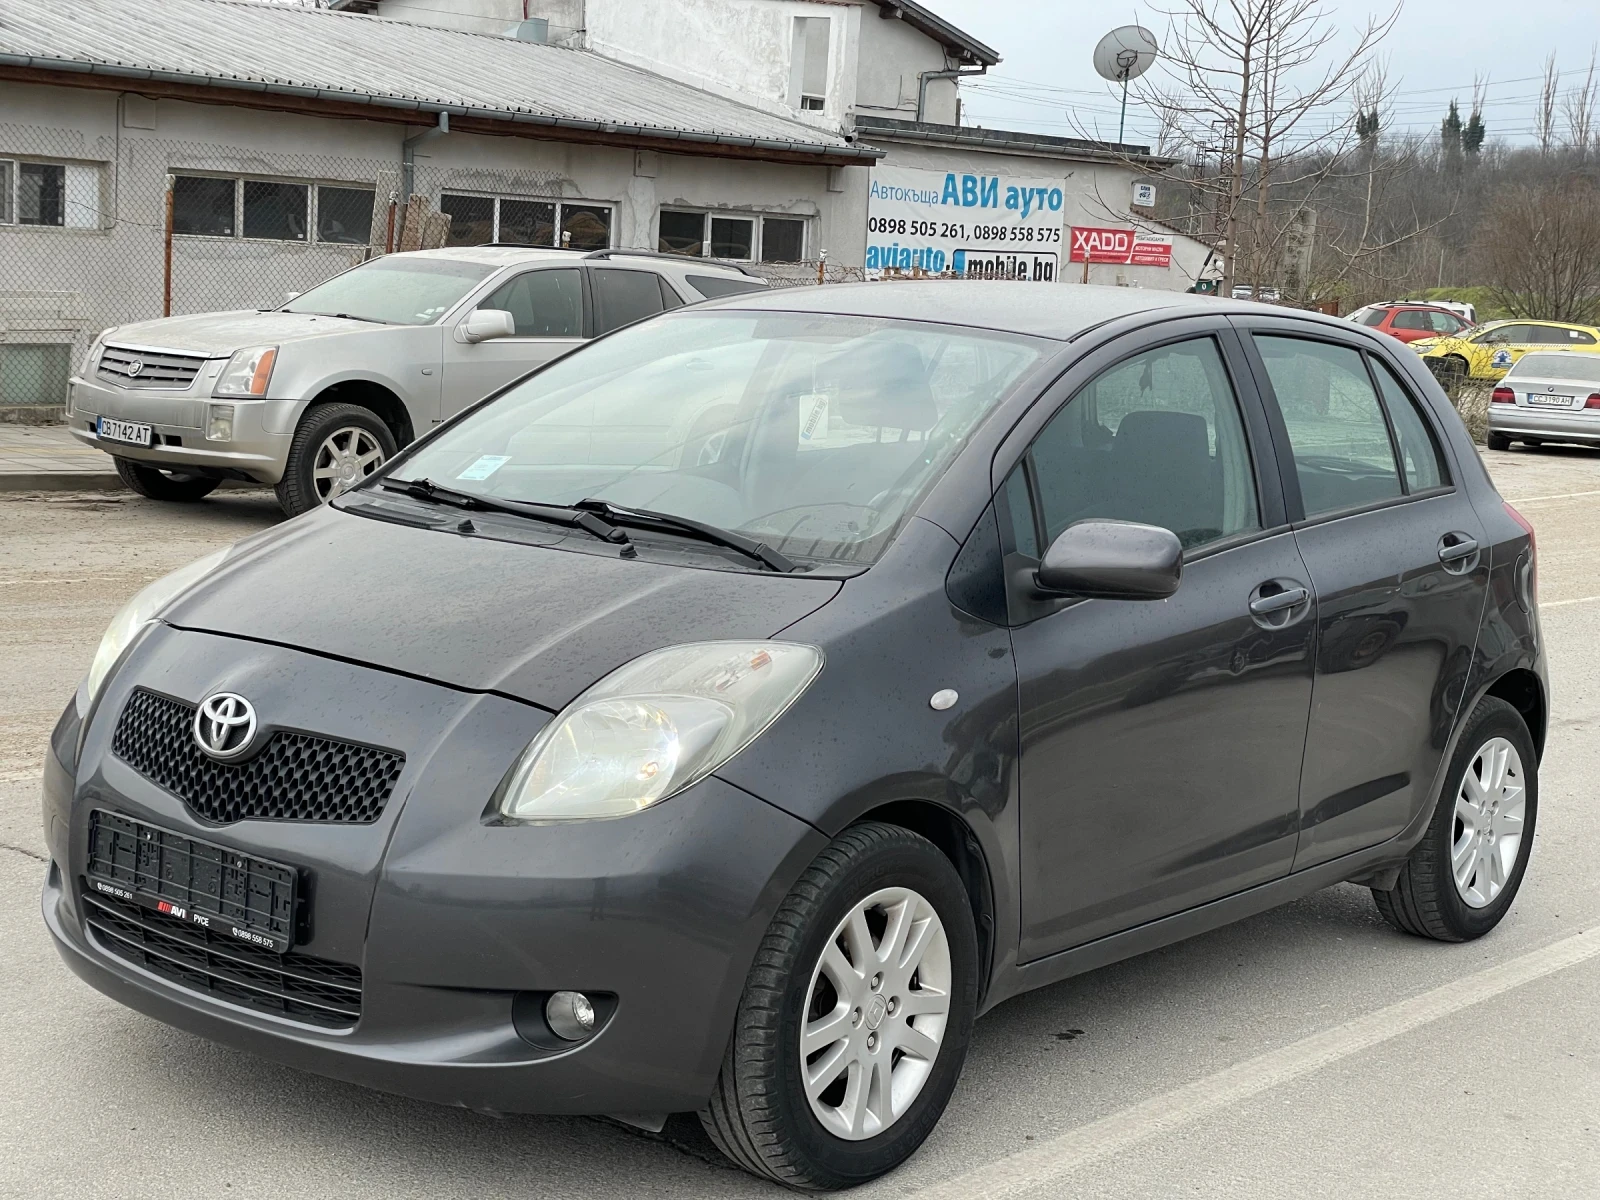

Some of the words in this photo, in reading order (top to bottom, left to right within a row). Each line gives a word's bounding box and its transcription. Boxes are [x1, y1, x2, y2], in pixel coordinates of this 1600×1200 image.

[869, 179, 939, 205] Автокъща
[941, 173, 999, 209] АВИ
[1005, 183, 1063, 220] ауто
[868, 216, 906, 235] 0898
[910, 220, 937, 237] 505
[940, 222, 970, 242] 261,
[974, 224, 1007, 241] 0898
[1009, 226, 1034, 242] 558
[1037, 227, 1060, 243] 575
[1073, 231, 1128, 252] XADO
[114, 888, 123, 897] 505
[123, 891, 133, 900] 261
[193, 914, 209, 927] РУСЕ
[251, 933, 263, 944] 558
[263, 937, 274, 948] 575
